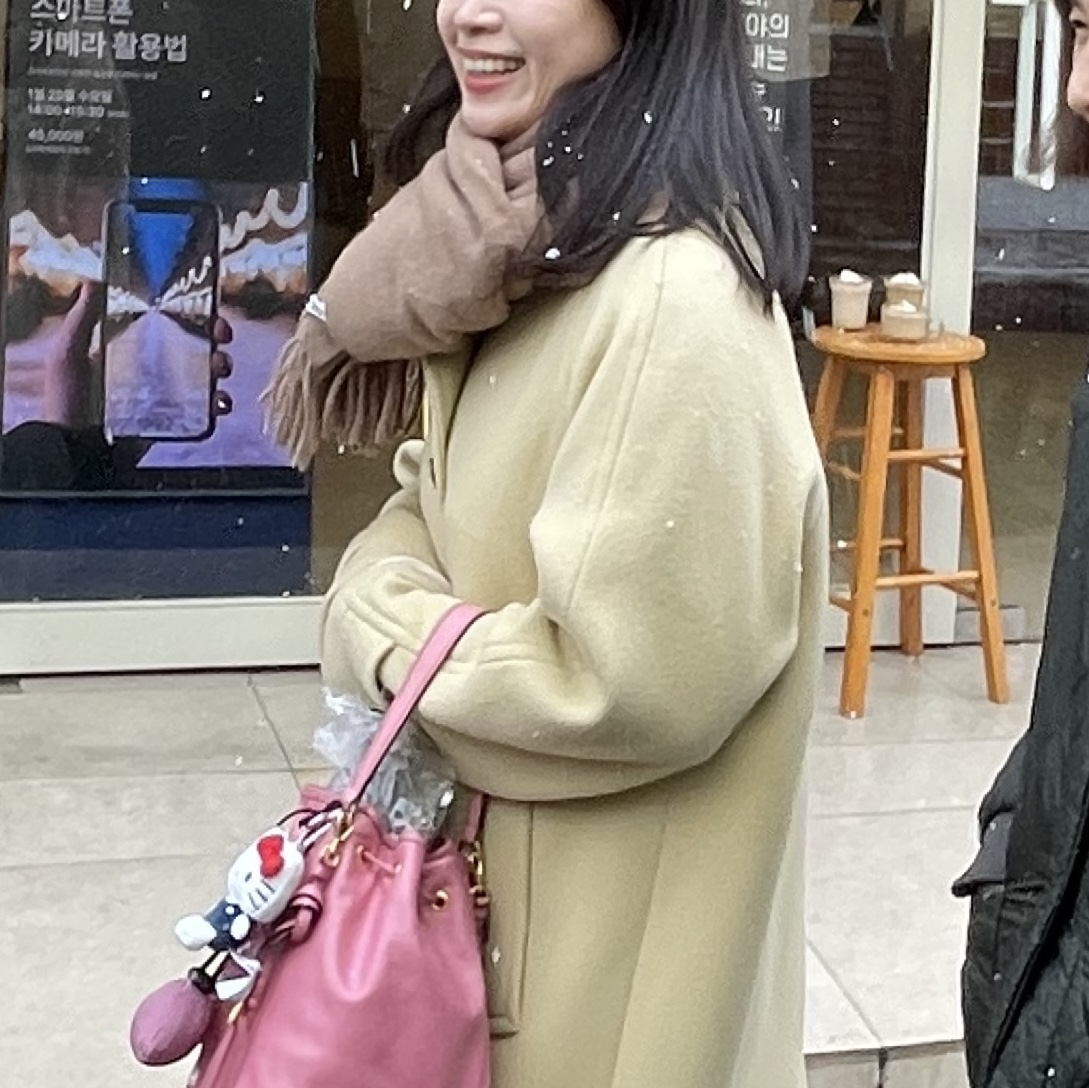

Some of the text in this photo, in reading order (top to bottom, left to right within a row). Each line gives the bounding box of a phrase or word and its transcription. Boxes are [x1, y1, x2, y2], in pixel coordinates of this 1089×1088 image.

[30, 0, 133, 25] 스마트폰
[745, 13, 789, 38] 야의
[29, 29, 187, 62] 카메라 활용법
